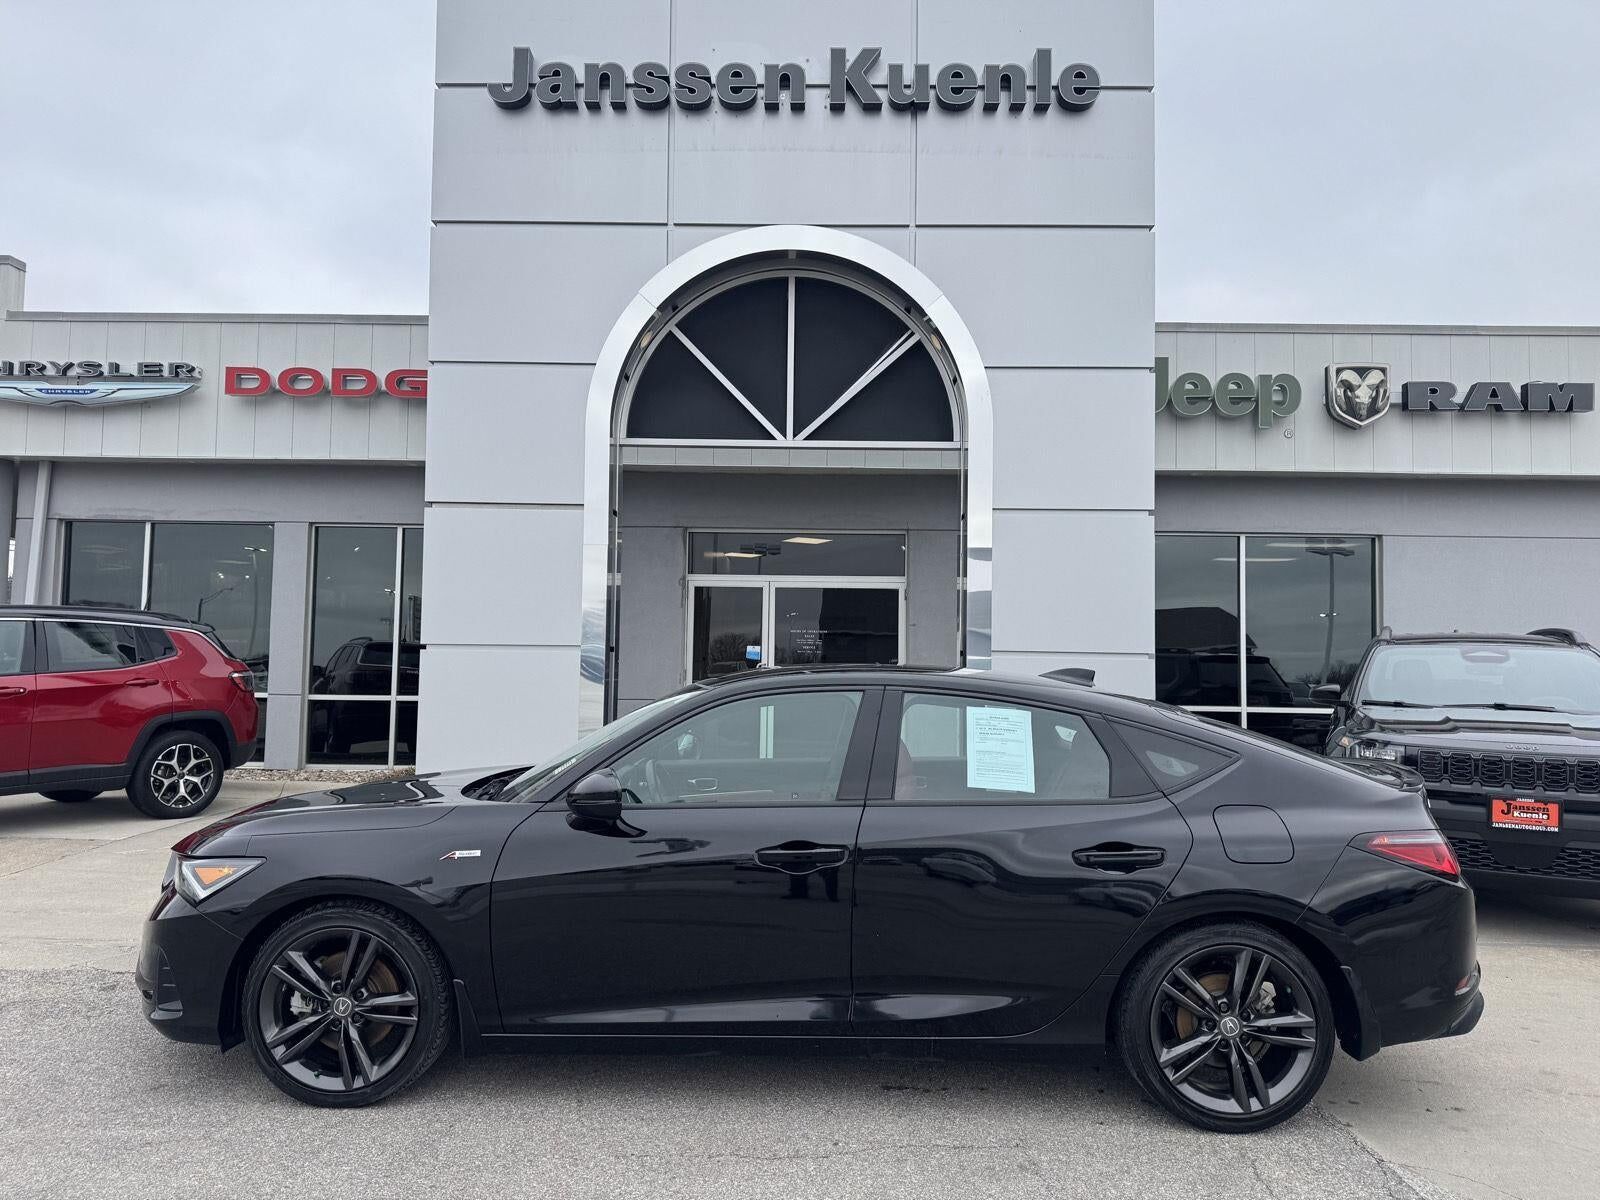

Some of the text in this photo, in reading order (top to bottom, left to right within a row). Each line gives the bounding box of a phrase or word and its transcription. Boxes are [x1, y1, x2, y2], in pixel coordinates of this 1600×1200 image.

[486, 46, 1102, 111] Janssen Kuenle
[1402, 381, 1596, 413] RAM
[1501, 802, 1550, 816] Janssen
[1513, 811, 1549, 820] Kuenle
